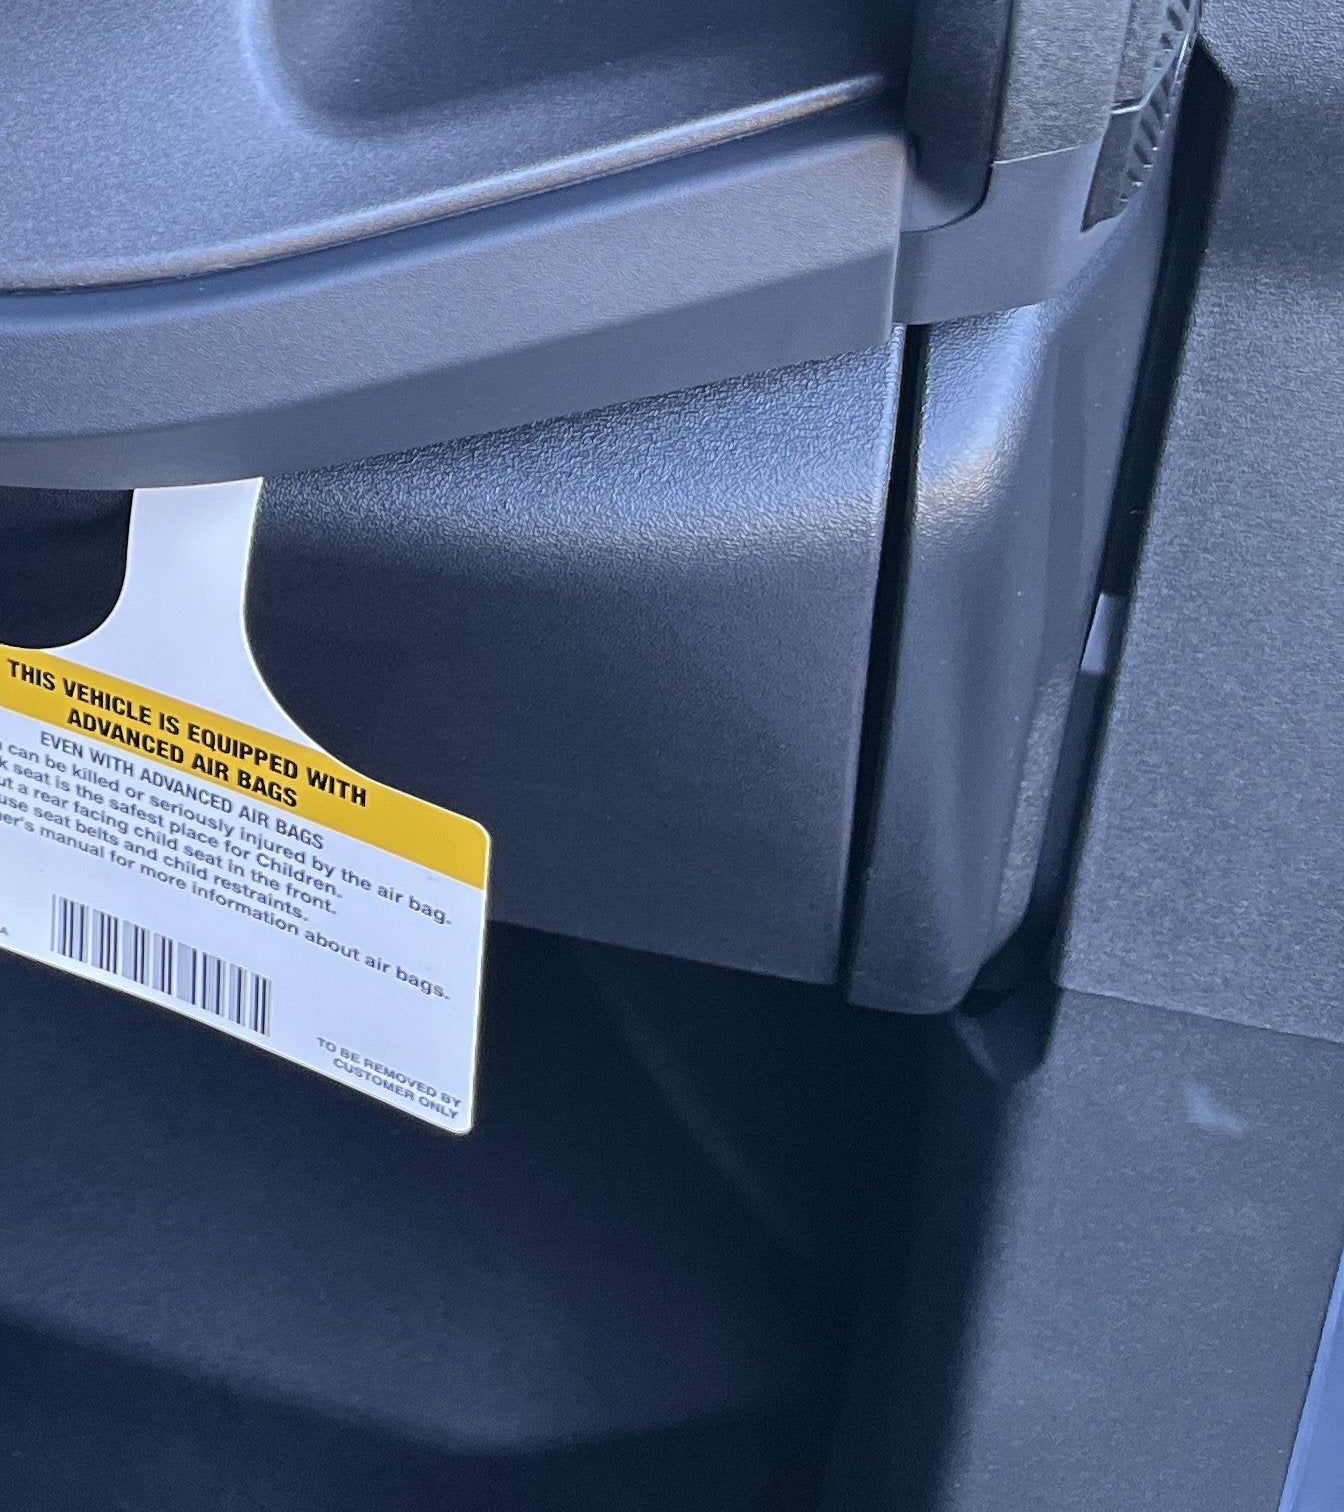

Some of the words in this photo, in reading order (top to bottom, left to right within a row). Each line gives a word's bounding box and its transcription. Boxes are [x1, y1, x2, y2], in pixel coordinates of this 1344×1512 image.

[7, 658, 56, 691] THIS
[62, 677, 152, 726] VEHICLE
[159, 712, 180, 735] IS
[187, 723, 298, 780] EQUIPPED
[306, 766, 367, 807] WITH
[40, 730, 83, 759] EVEN
[89, 747, 134, 777] WITH
[140, 768, 232, 813] ADVANCED
[239, 805, 269, 829] AIR
[276, 819, 324, 850] BAGS
[67, 708, 184, 764] ADVANCED
[191, 753, 229, 782] AIR
[237, 769, 297, 807] BAGS
[8, 744, 40, 764] can
[45, 754, 66, 772] be
[72, 763, 119, 792] killed
[125, 785, 145, 801] or
[149, 795, 234, 838] seriously
[240, 827, 305, 864] injured
[312, 855, 336, 878] by
[341, 868, 372, 890] the
[377, 885, 403, 903] air
[409, 895, 452, 924] bag.
[14, 763, 49, 785] seat
[55, 776, 70, 792] is
[76, 782, 104, 804] the
[109, 798, 165, 827] safest
[170, 821, 219, 848] place
[225, 840, 251, 860] for
[256, 852, 342, 899] Children.
[18, 783, 28, 795] a
[34, 788, 69, 809] rear
[74, 800, 129, 835] facing
[134, 824, 178, 851] child
[183, 845, 224, 869] seat
[228, 859, 245, 877] in
[251, 869, 280, 890] the
[286, 882, 337, 915] front.
[33, 806, 71, 828] seat
[76, 819, 119, 846] belts
[124, 839, 158, 861] and
[163, 854, 208, 880] child
[213, 874, 309, 922] restraints.
[39, 825, 105, 858] manual
[110, 850, 136, 869] for
[140, 863, 187, 889] more
[192, 881, 300, 935] information
[304, 930, 361, 961] about
[365, 955, 391, 973] air
[396, 965, 450, 1000] bags.
[316, 1037, 337, 1053] TO
[340, 1047, 360, 1064] BE
[364, 1058, 437, 1097] REMOVED
[441, 1092, 461, 1108] BY
[333, 1057, 415, 1101] CUSTOMER
[418, 1096, 459, 1120] ONLY
